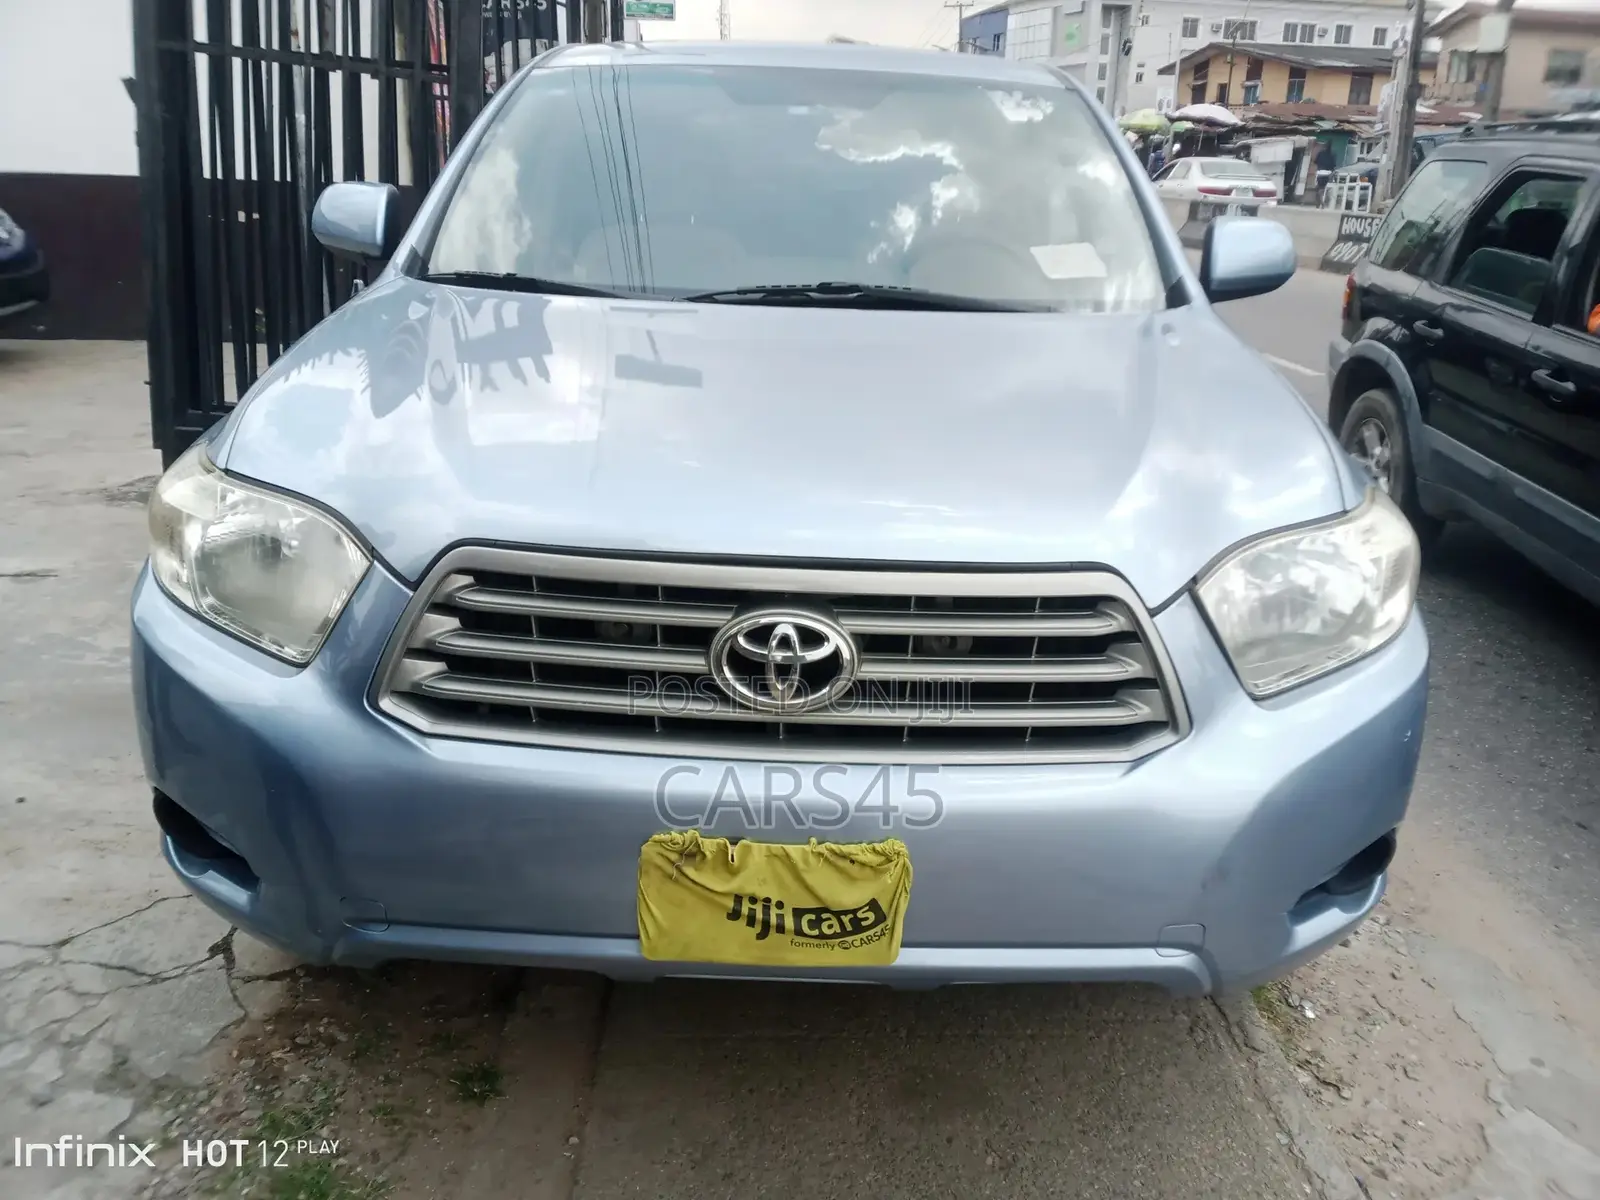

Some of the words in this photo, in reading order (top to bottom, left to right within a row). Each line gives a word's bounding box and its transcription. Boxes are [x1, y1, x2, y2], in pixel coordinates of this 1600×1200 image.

[726, 893, 786, 941] Jiji
[800, 905, 876, 937] cars
[790, 938, 836, 950] formerly
